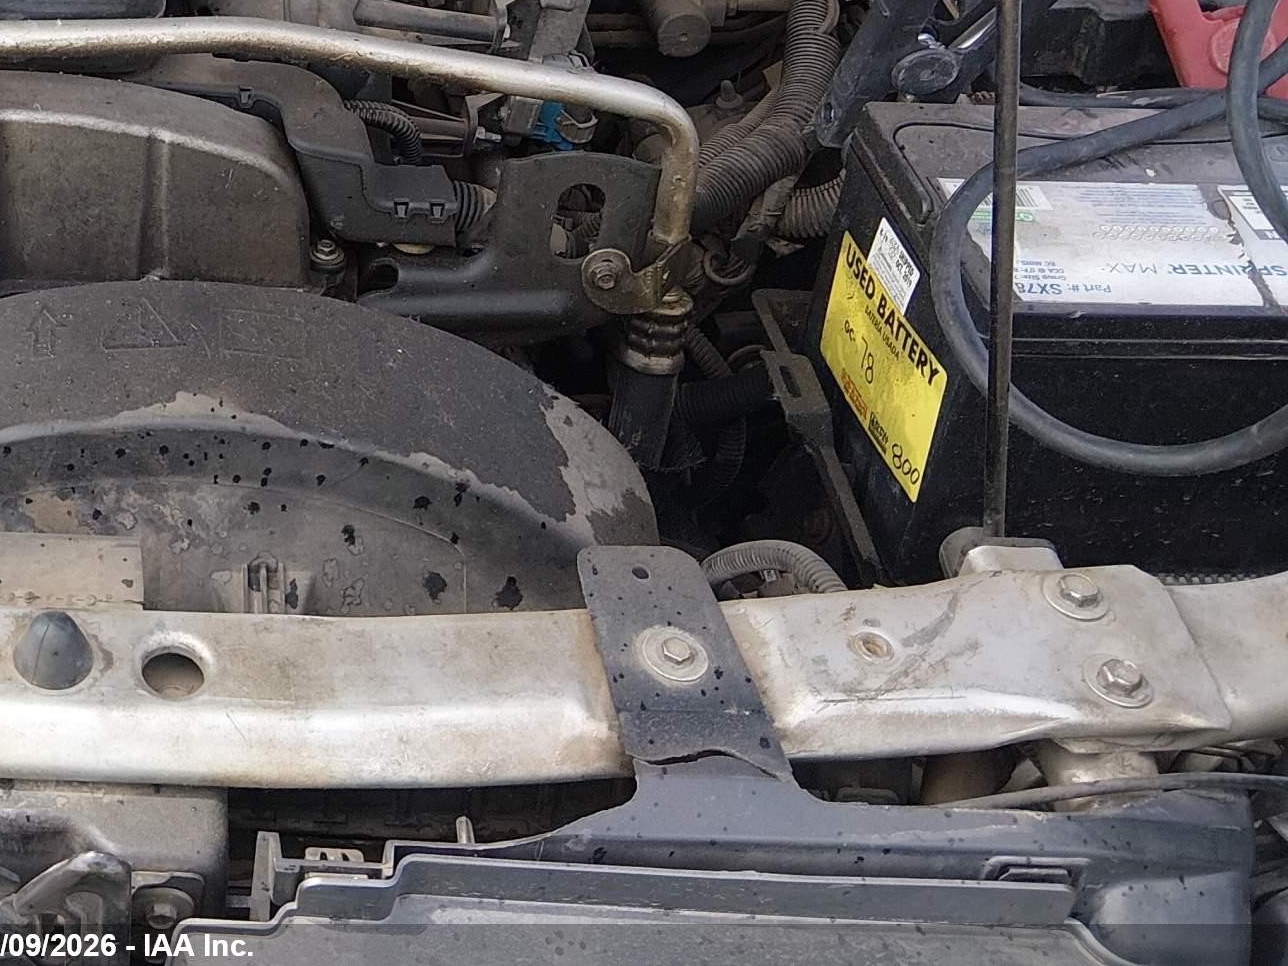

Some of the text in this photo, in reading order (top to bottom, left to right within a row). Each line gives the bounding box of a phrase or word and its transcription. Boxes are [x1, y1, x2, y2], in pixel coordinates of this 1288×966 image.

[1106, 263, 1158, 275] MAX
[1082, 284, 1112, 293] Part
[846, 242, 876, 300] USED
[877, 293, 940, 386] BATTERY
[861, 336, 875, 384] 78
[882, 331, 900, 361] USADA
[891, 443, 920, 485] 800
